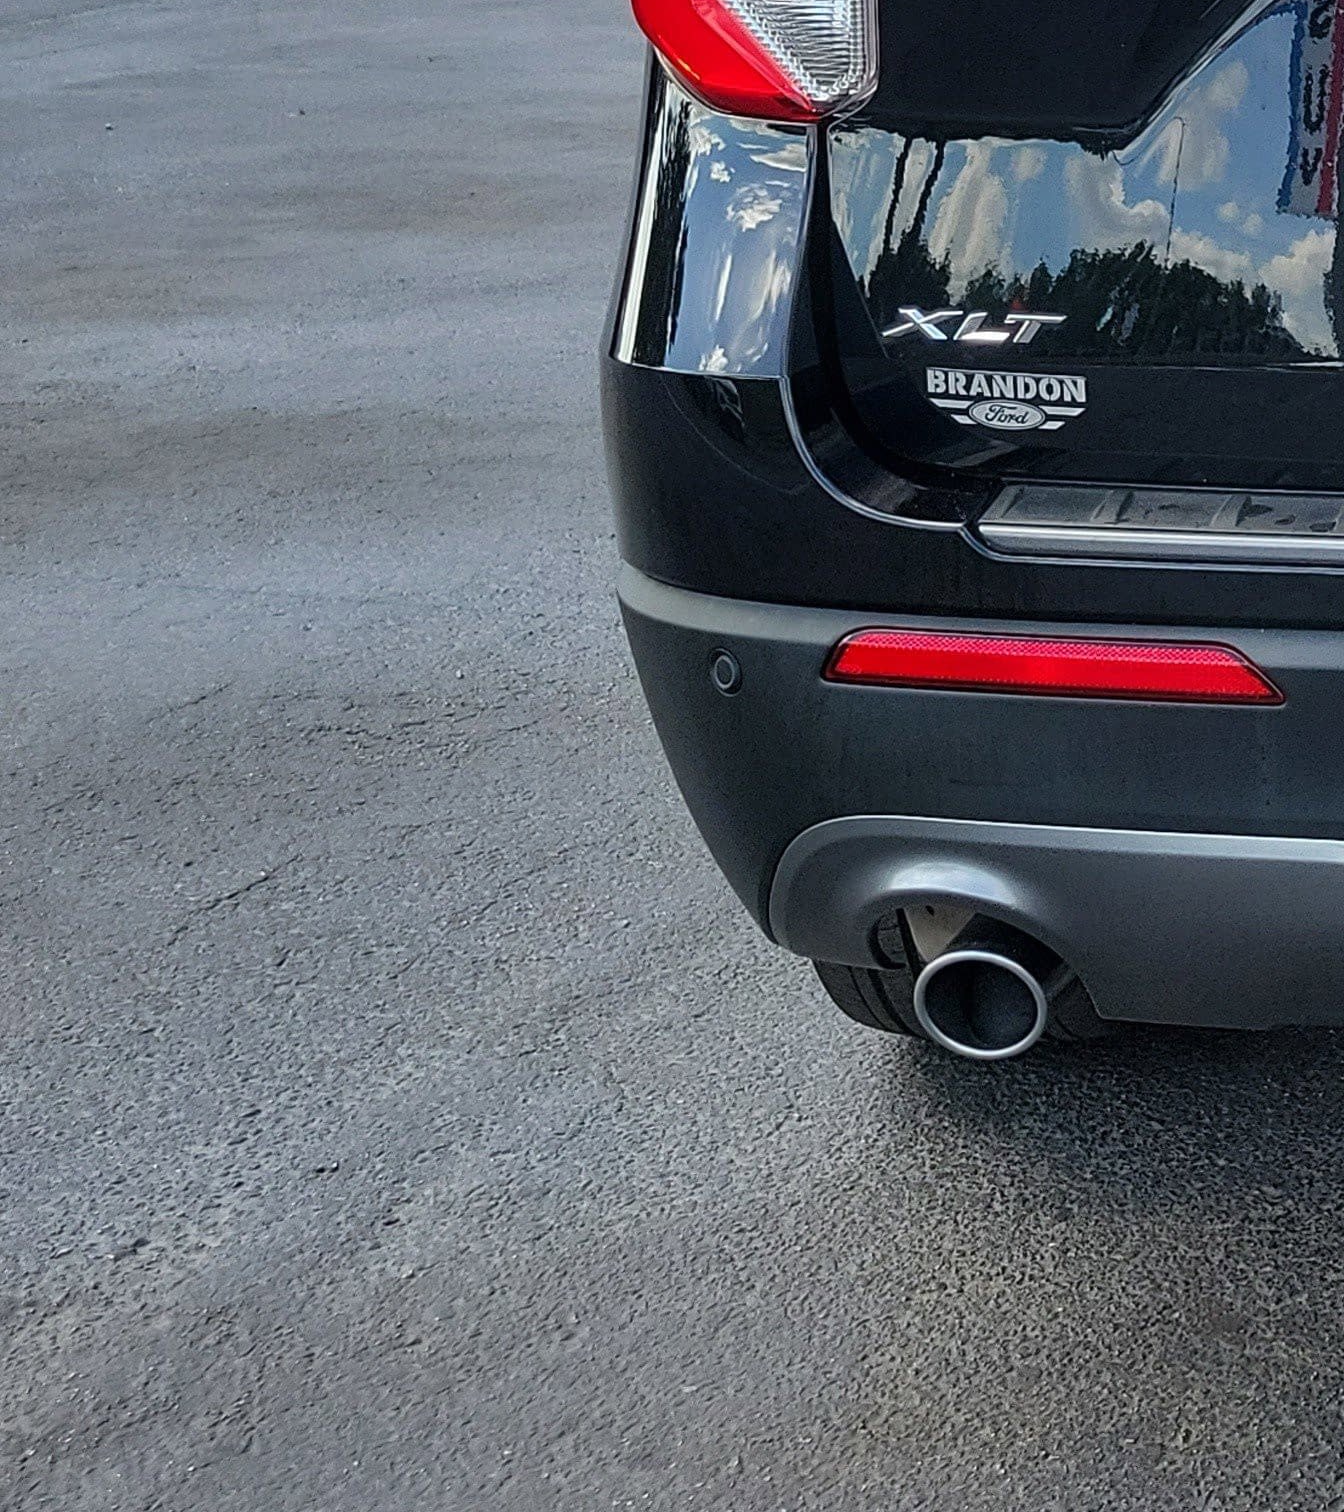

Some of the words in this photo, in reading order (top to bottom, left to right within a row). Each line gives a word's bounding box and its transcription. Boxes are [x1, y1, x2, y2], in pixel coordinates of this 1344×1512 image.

[882, 307, 1067, 344] XLT
[926, 367, 1088, 403] BRANDON
[984, 403, 1030, 425] Ford
